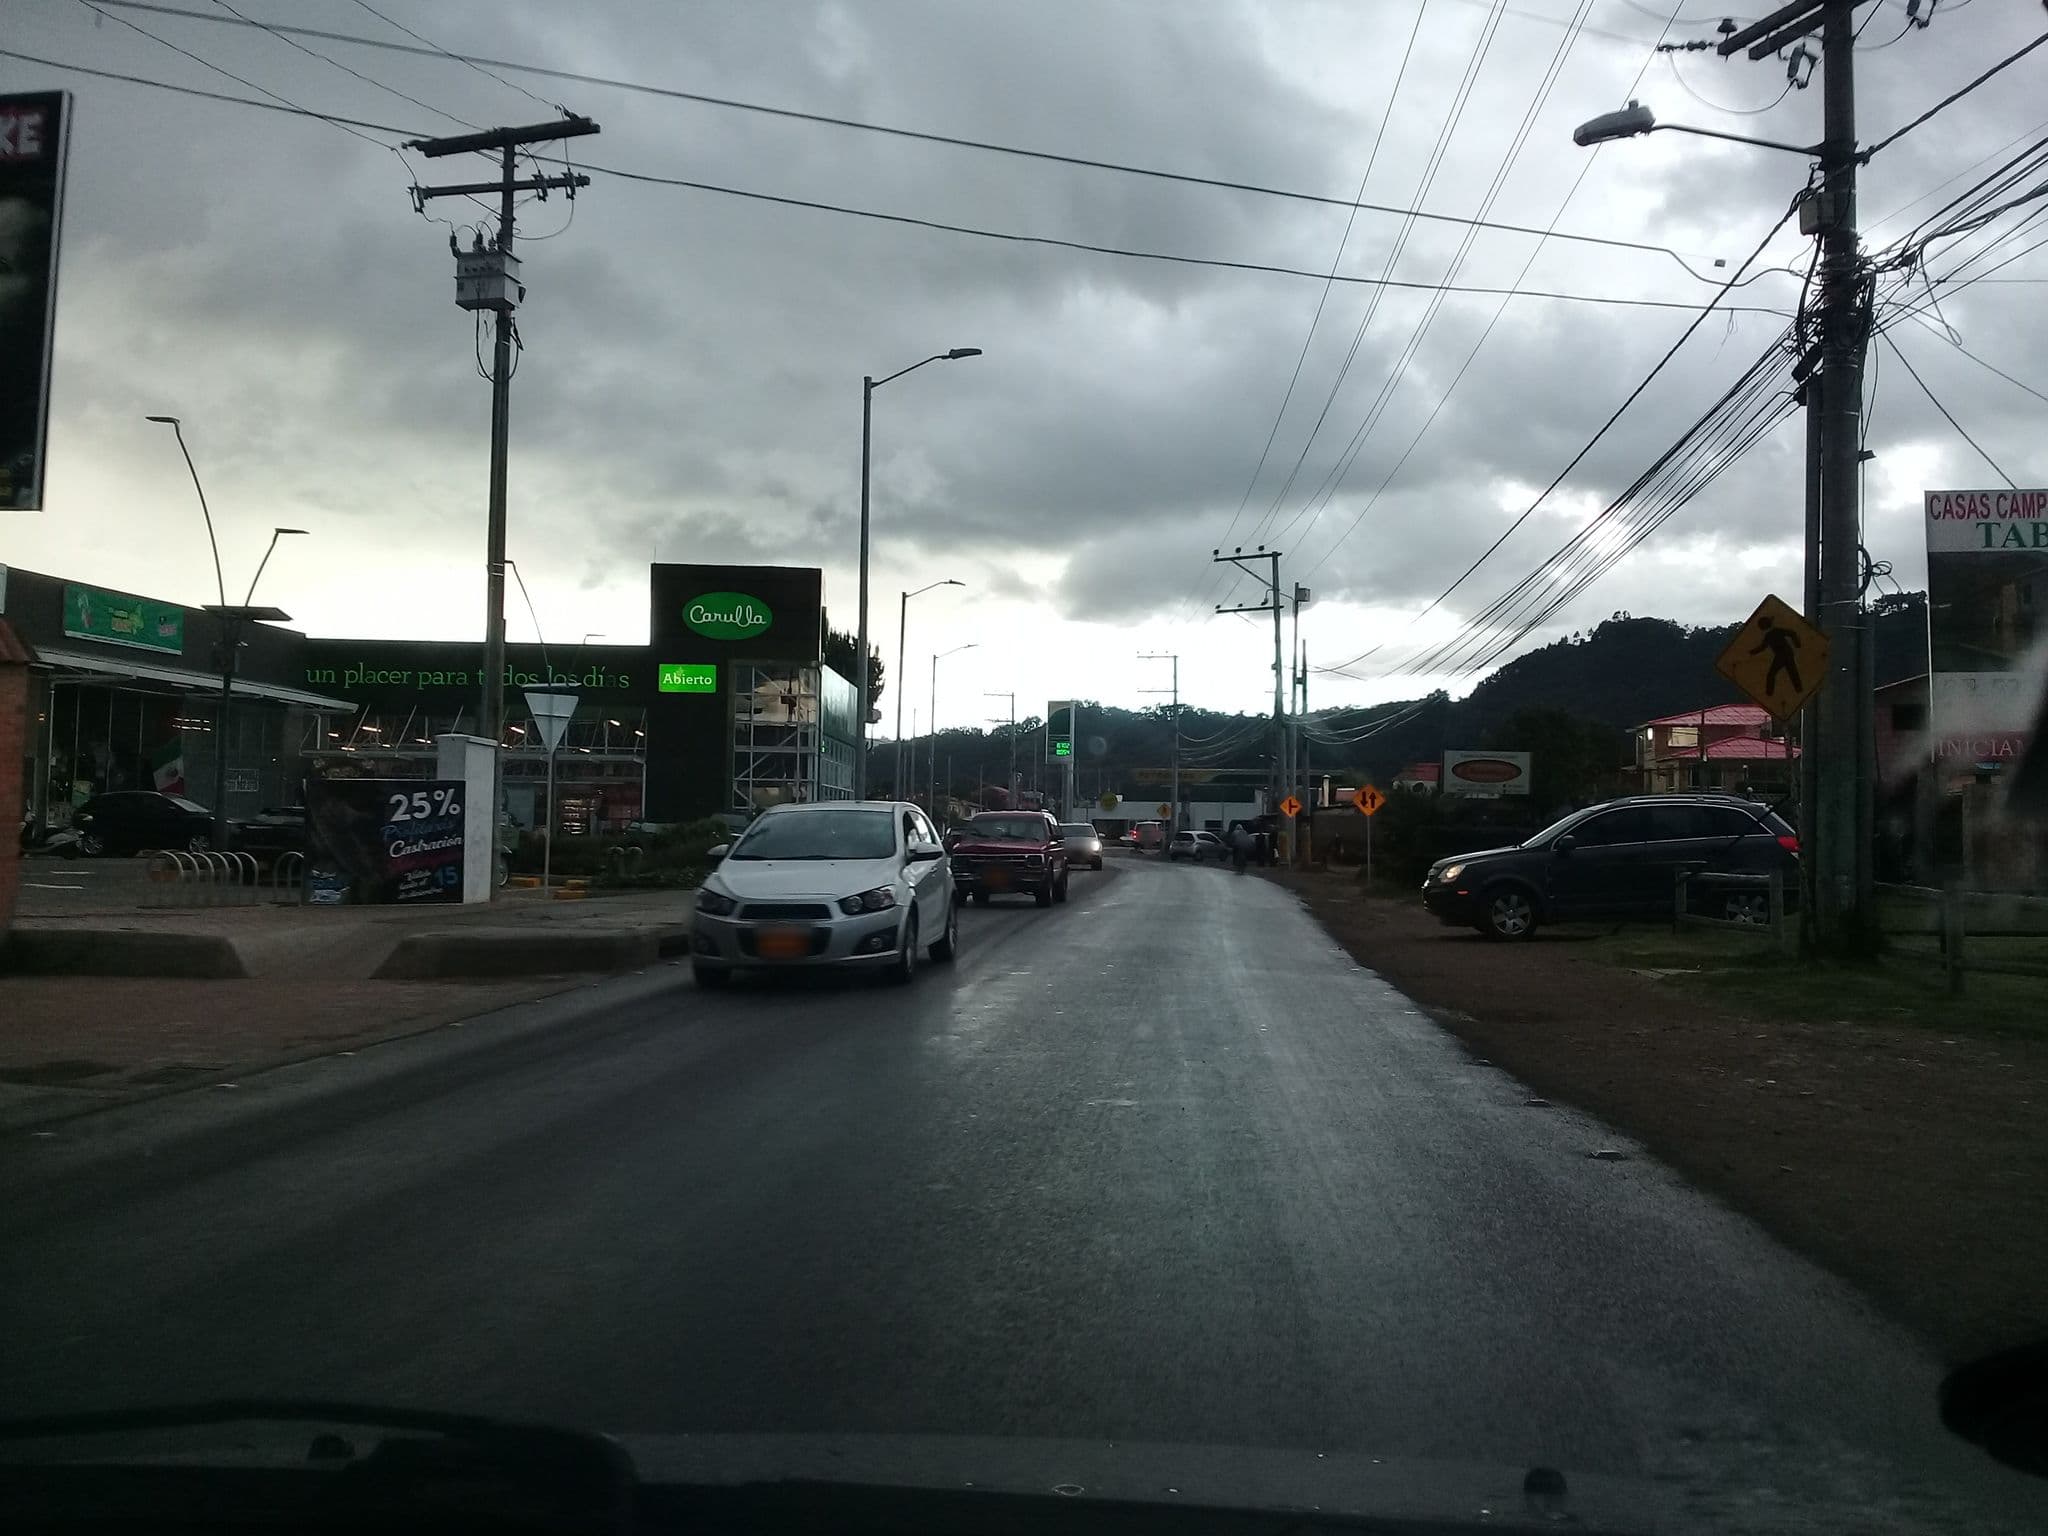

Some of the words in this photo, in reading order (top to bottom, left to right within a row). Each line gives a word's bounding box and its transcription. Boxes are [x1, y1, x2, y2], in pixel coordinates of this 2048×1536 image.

[1930, 494, 1991, 520] CASAS
[1996, 492, 2048, 519] CAMP
[1976, 521, 2048, 549] TAB
[690, 604, 768, 628] Carulla
[306, 668, 337, 684] un
[344, 661, 412, 689] placer
[416, 670, 468, 690] para
[478, 665, 539, 686] tdos
[546, 665, 577, 685] los
[583, 666, 630, 688] días
[662, 673, 712, 685] Abierto
[390, 788, 461, 822] 25%
